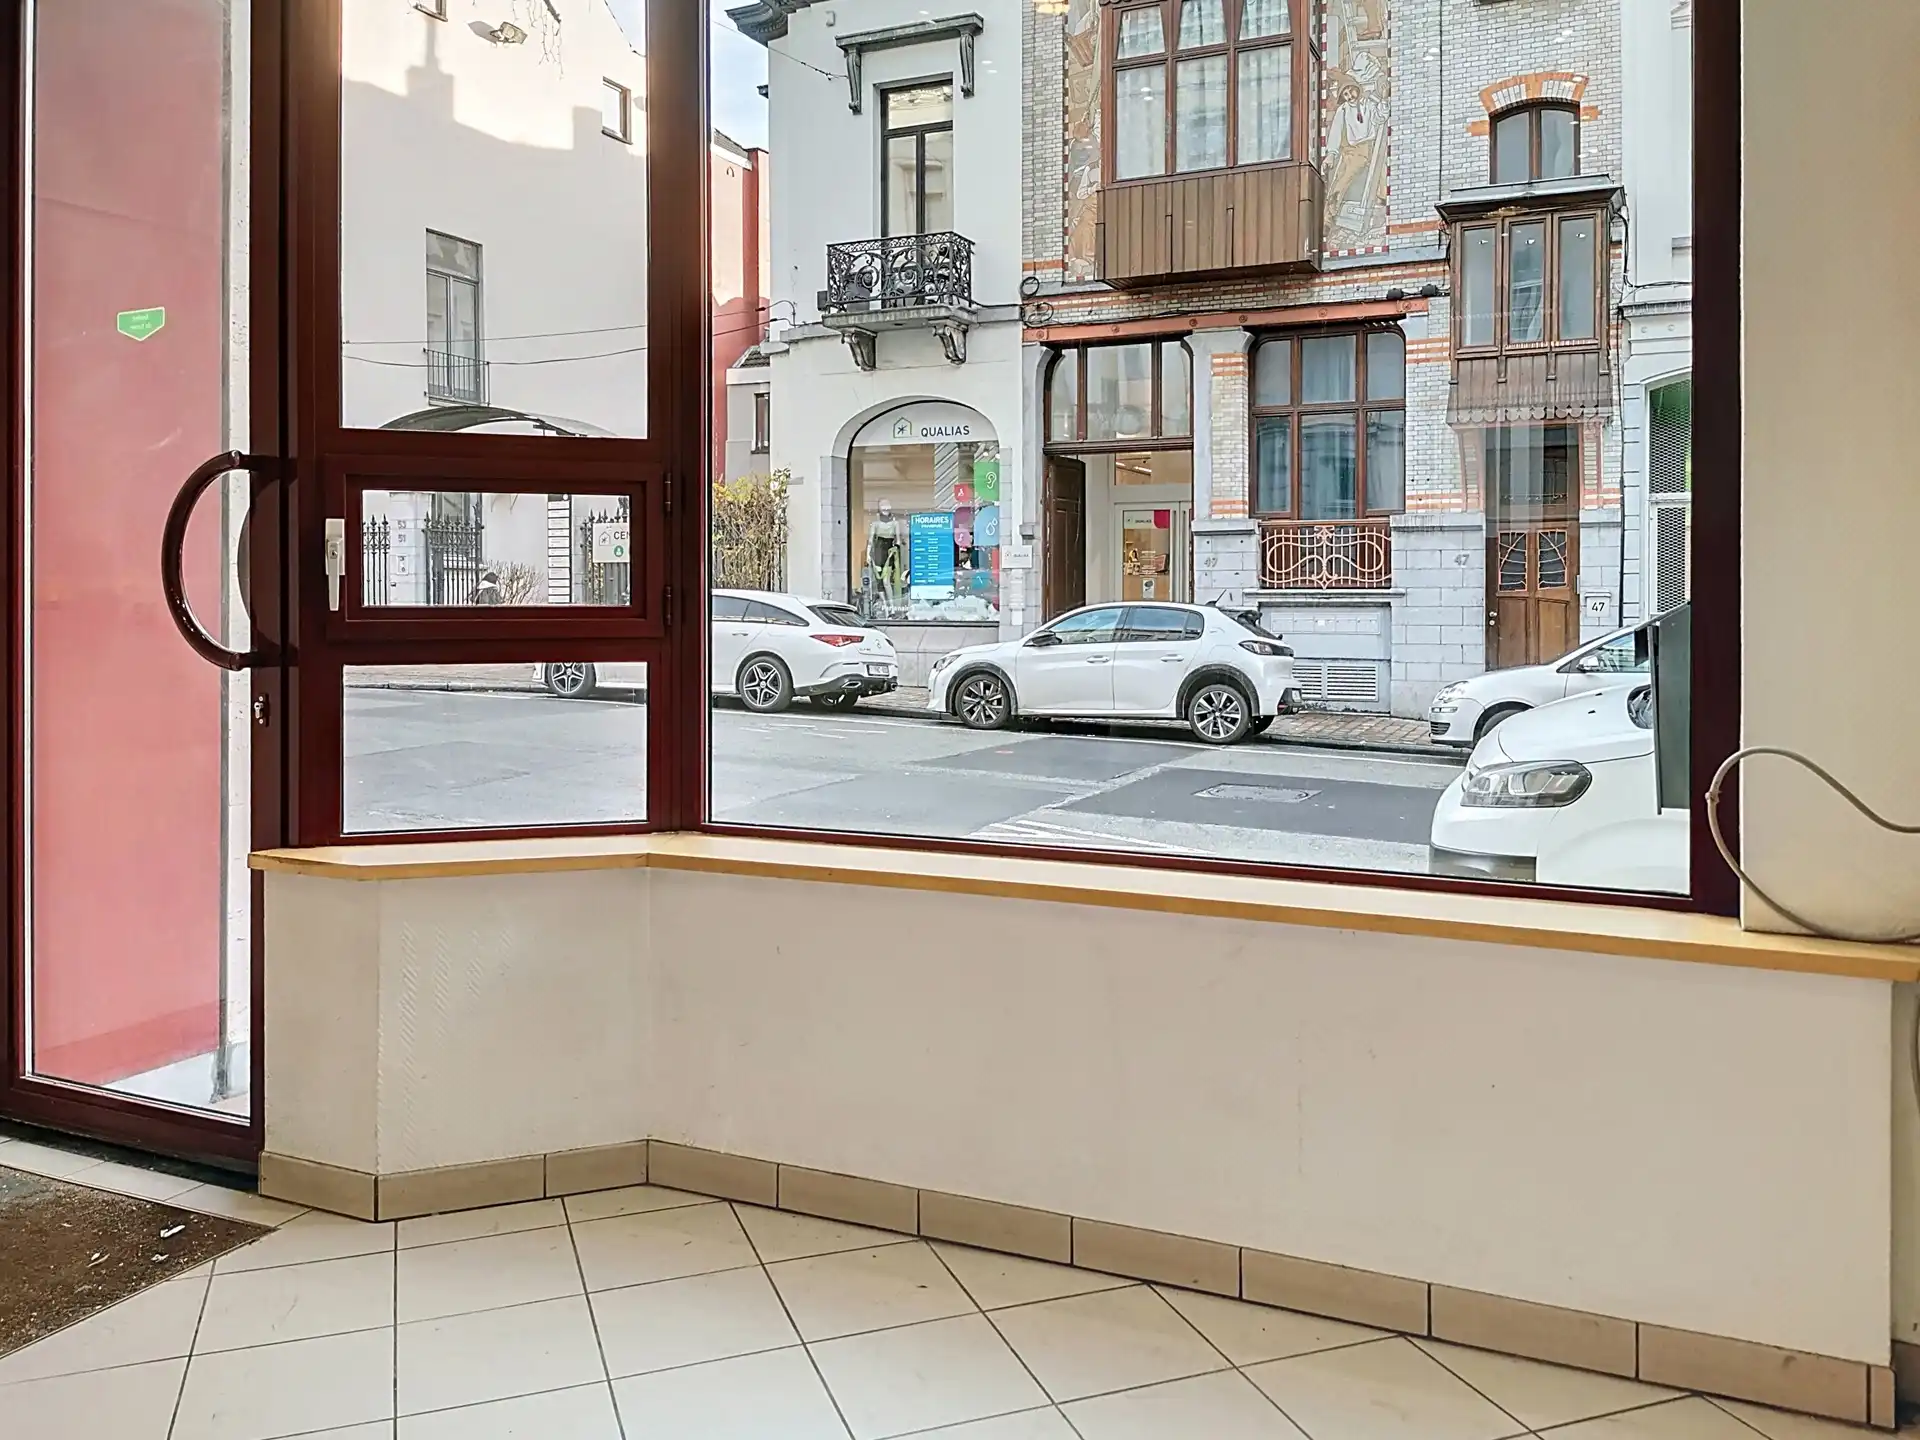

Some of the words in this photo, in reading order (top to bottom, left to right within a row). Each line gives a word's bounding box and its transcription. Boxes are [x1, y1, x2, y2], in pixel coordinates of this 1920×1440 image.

[921, 425, 970, 438] QUALIAS
[916, 516, 949, 524] HORAIRES
[1454, 554, 1470, 566] 47
[1592, 602, 1605, 612] 47
